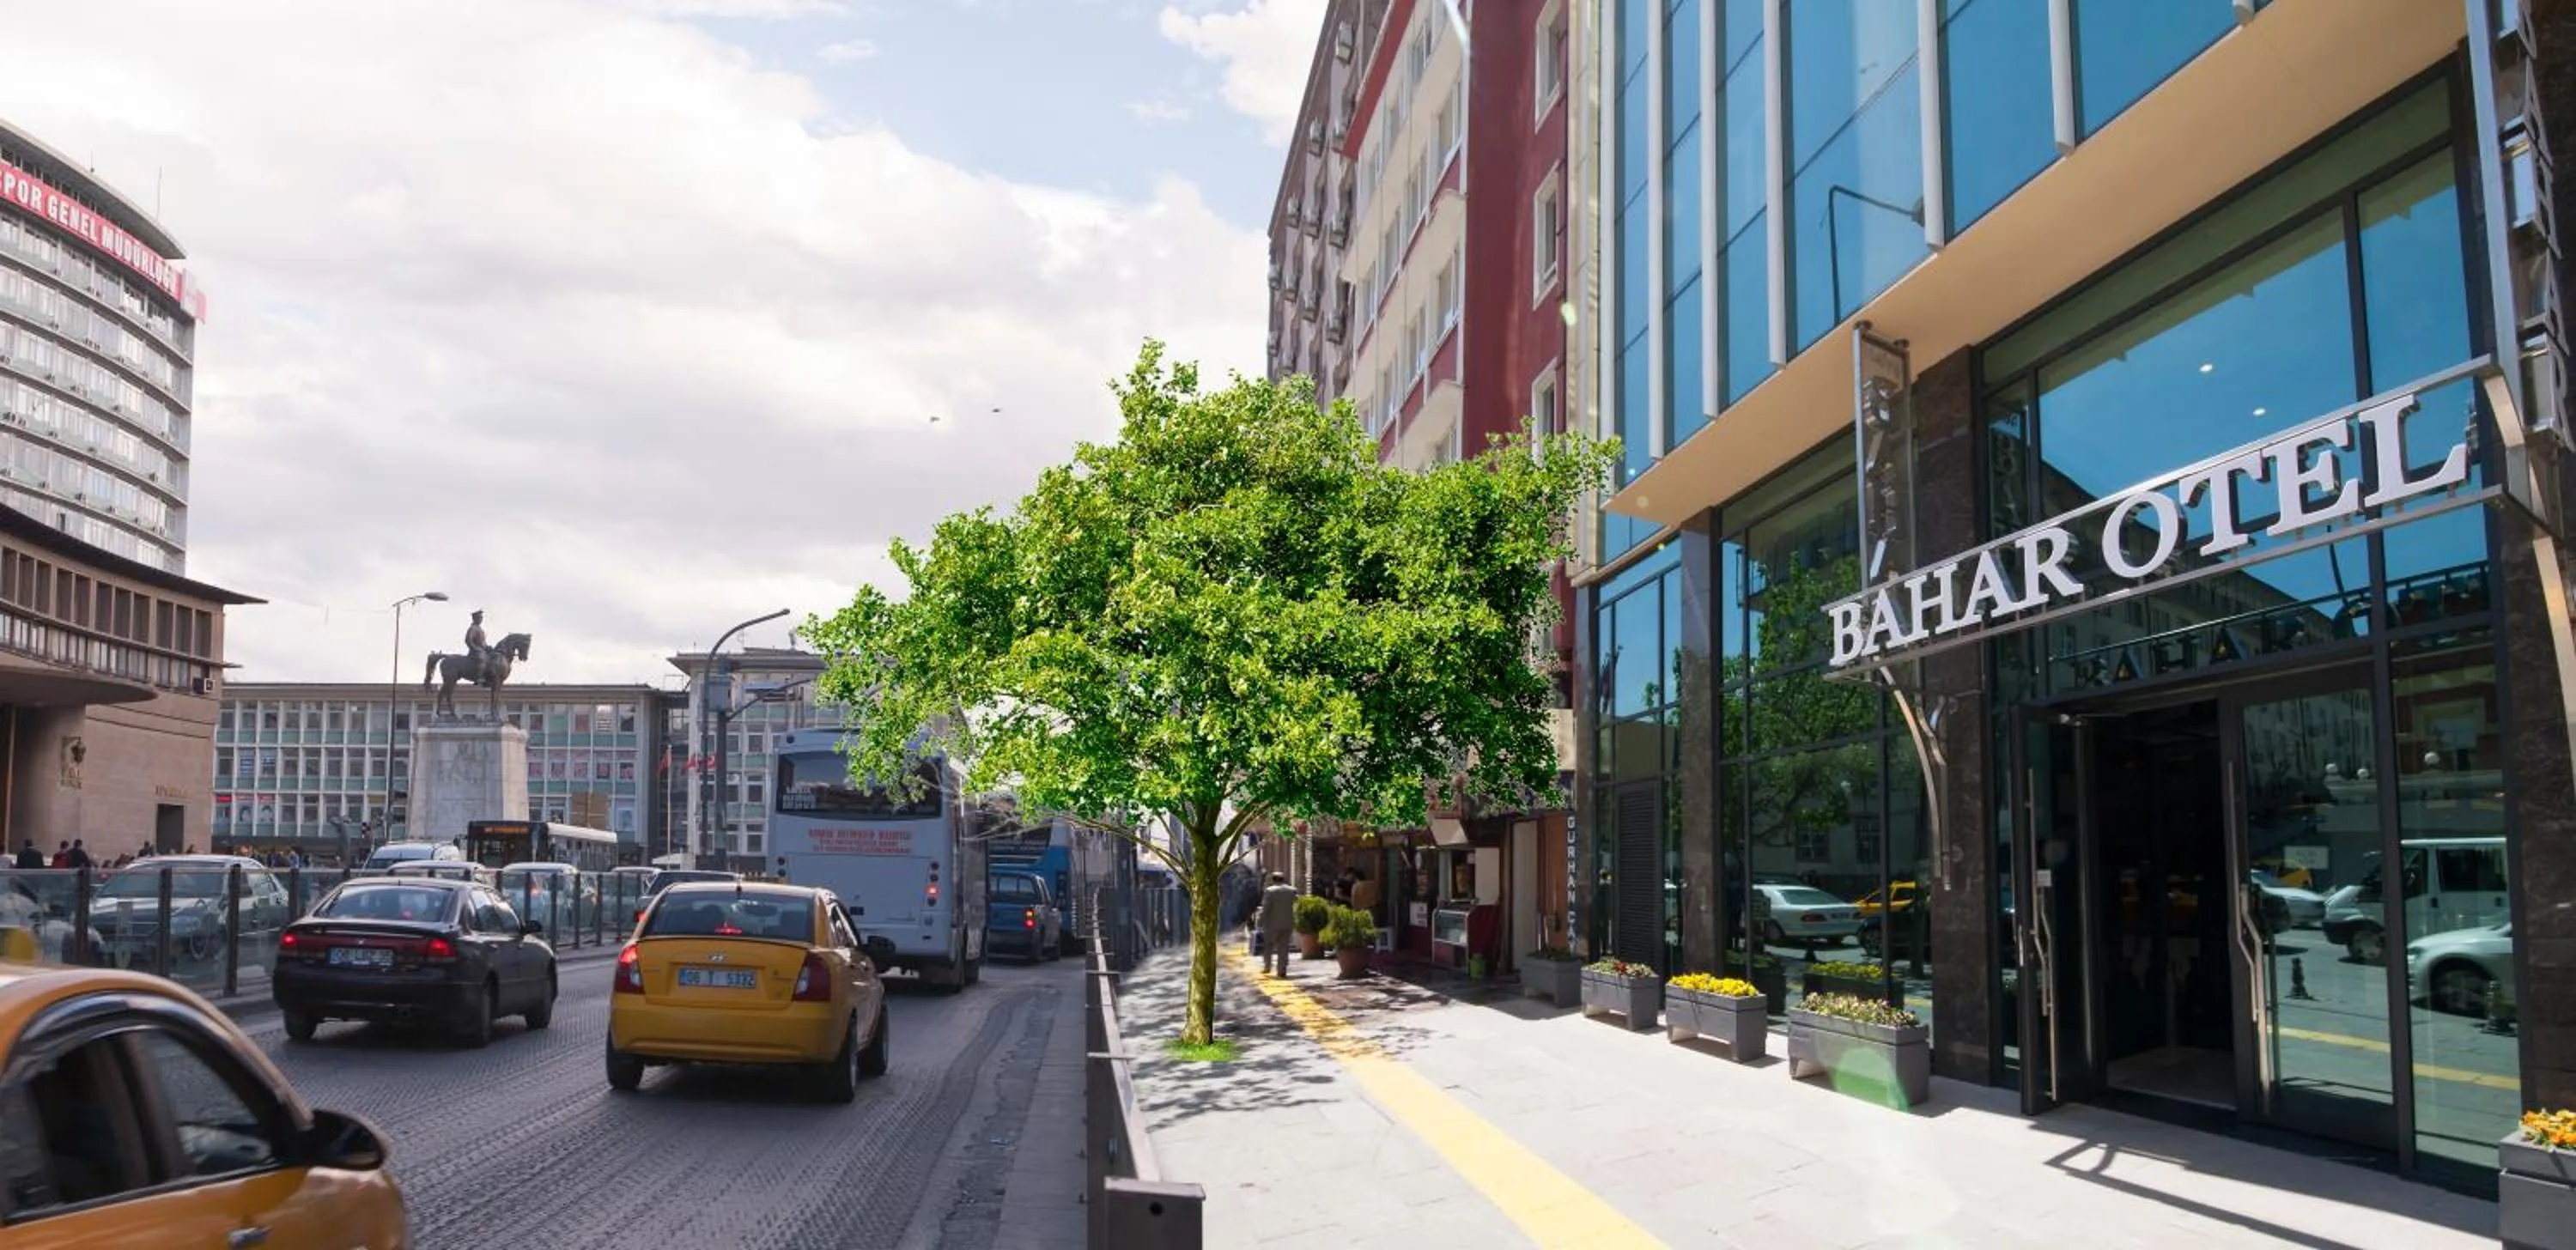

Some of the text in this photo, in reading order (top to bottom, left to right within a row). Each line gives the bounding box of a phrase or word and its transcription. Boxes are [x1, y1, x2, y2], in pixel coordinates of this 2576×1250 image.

[0, 172, 42, 212] POR
[48, 194, 97, 240] GENEL
[1828, 526, 2085, 667] BAHAR
[2101, 393, 2470, 579] OTEL
